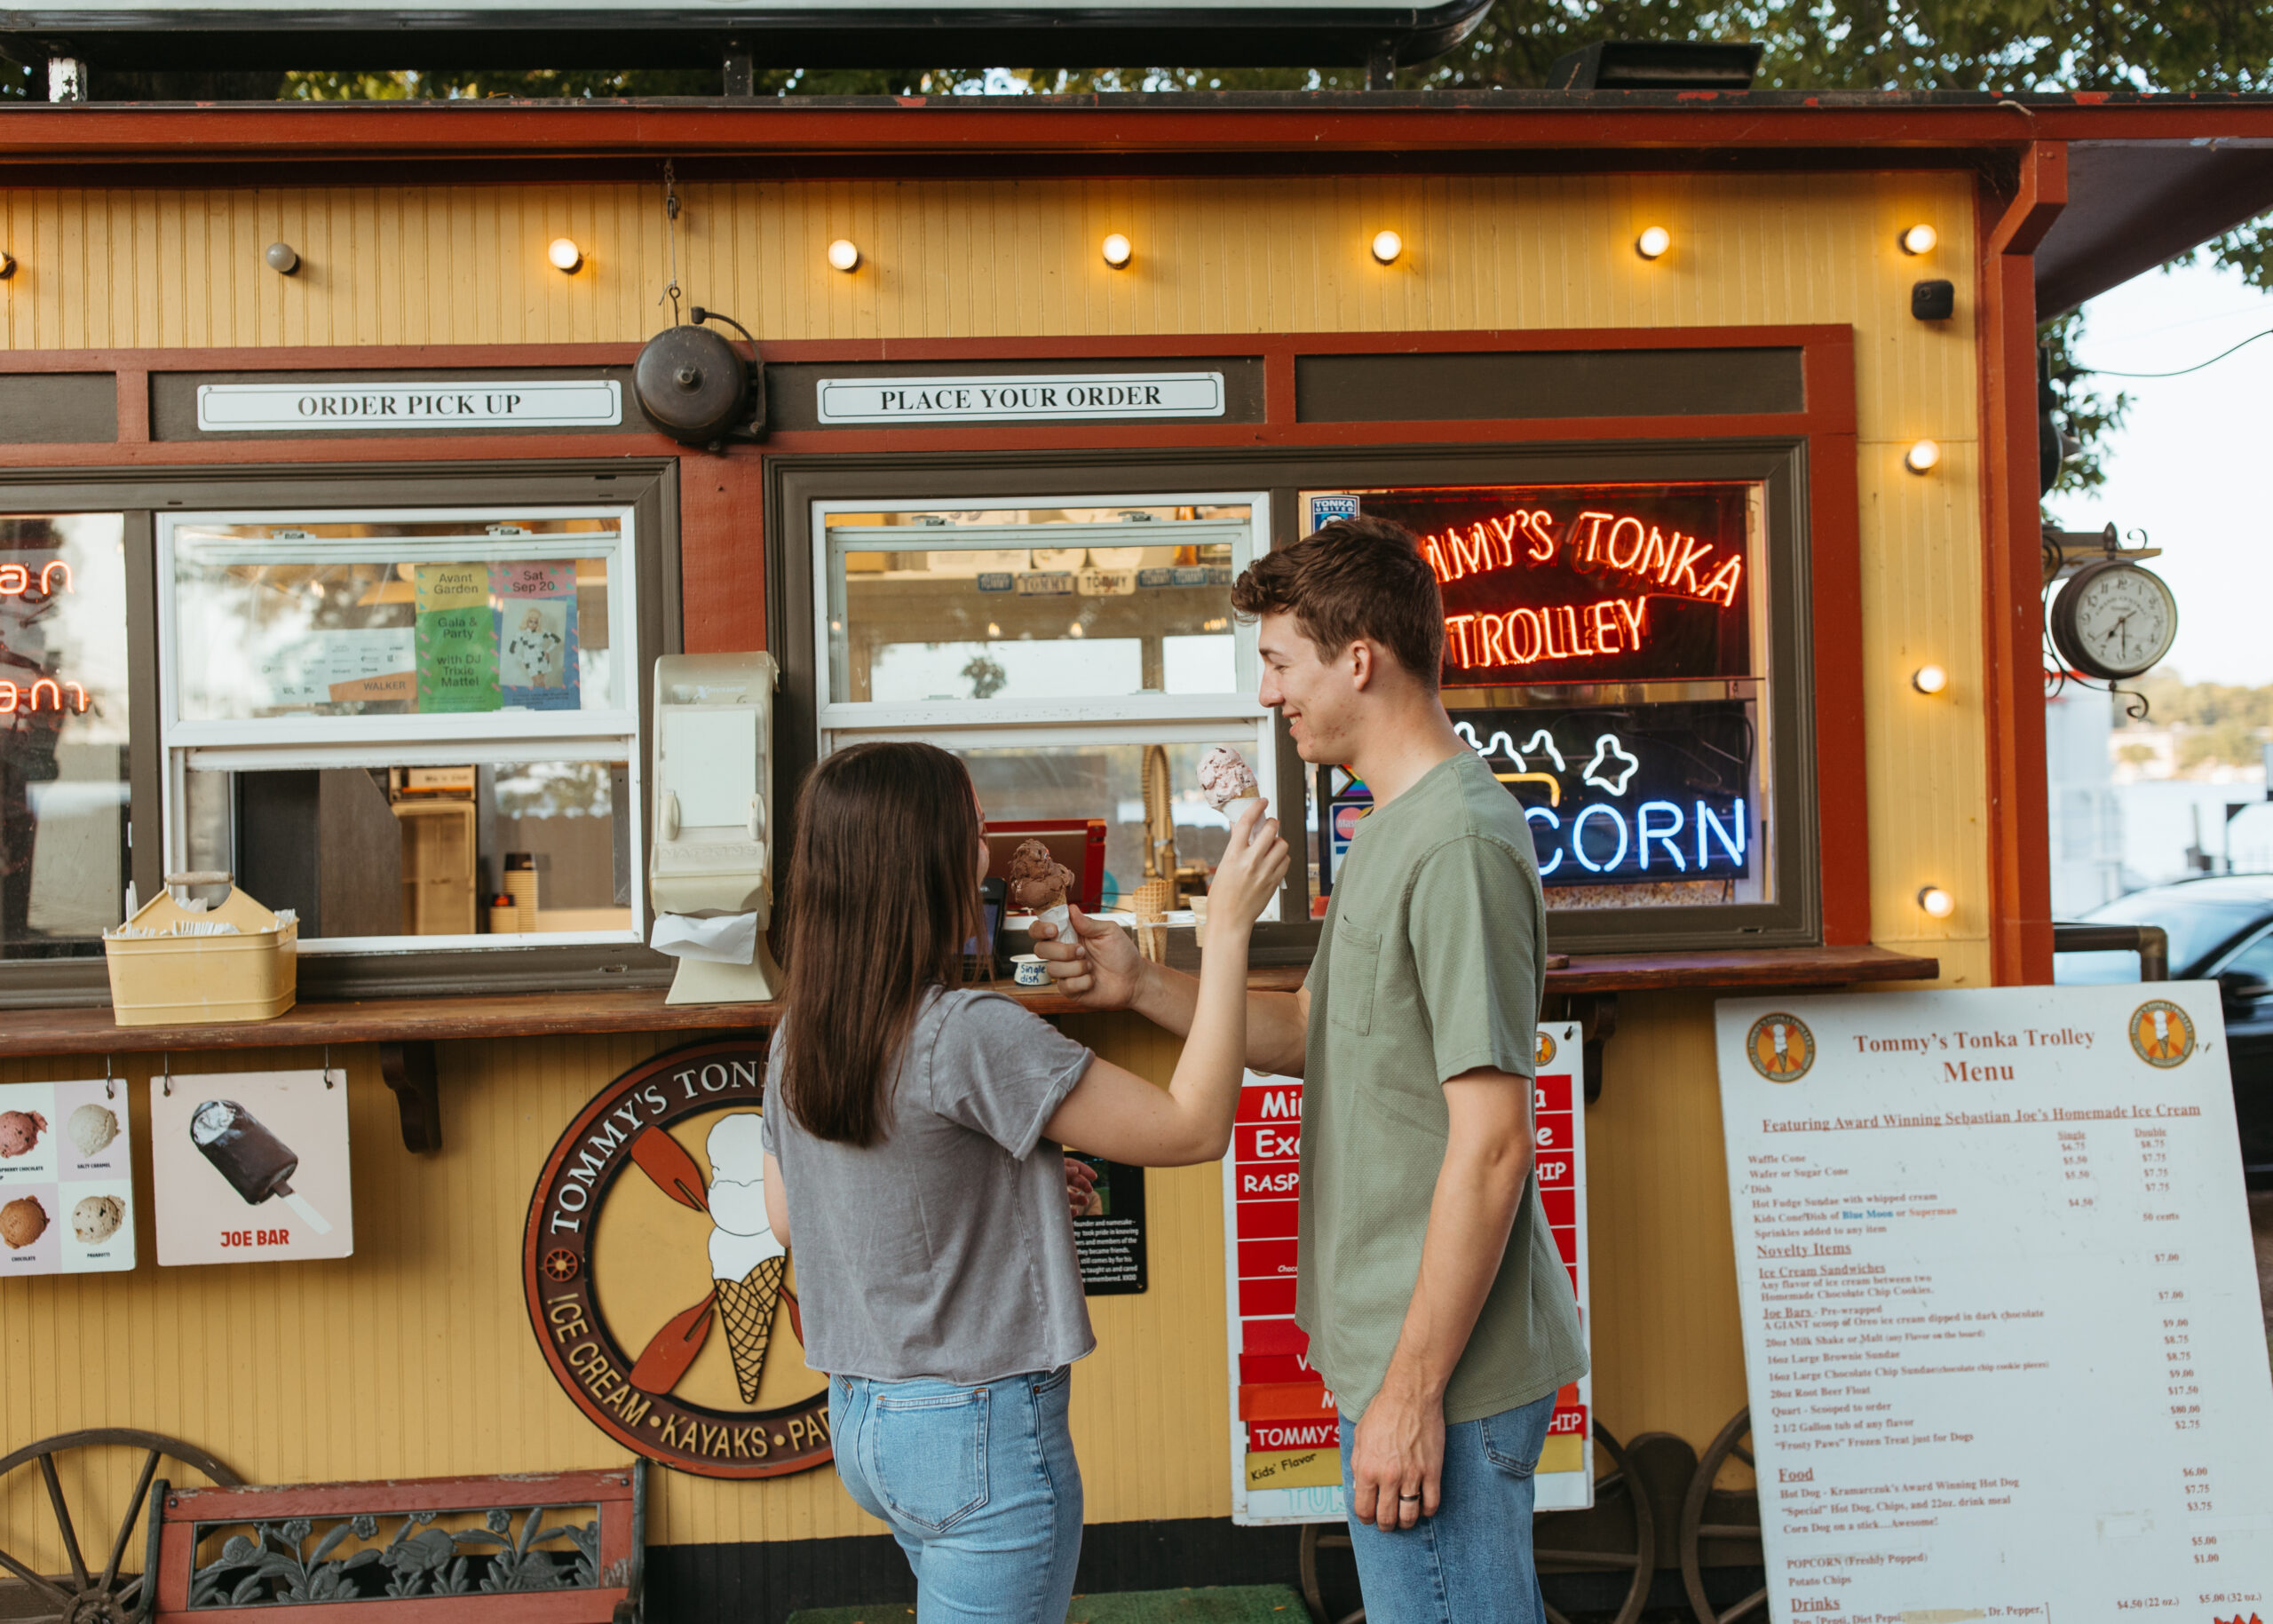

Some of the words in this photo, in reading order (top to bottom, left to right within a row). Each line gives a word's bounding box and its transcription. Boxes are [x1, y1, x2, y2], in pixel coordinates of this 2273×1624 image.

[297, 395, 397, 416] ORDER
[408, 395, 475, 415] PICK
[485, 395, 521, 413] UP
[881, 390, 971, 410] PLACE
[980, 388, 1057, 408] YOUR
[1066, 387, 1162, 408] ORDER
[1580, 511, 1740, 606] TONKA
[439, 574, 472, 582] Avant
[524, 571, 543, 581] Sat
[434, 584, 478, 594] Garden
[513, 582, 536, 593] Sep
[540, 582, 555, 590] 20
[438, 618, 465, 628] Gala
[469, 617, 477, 626] &
[443, 630, 473, 640] Party
[1445, 596, 1645, 669] TROLLEY
[437, 655, 463, 664] with
[466, 654, 481, 664] DJ
[444, 666, 473, 676] Trixie
[364, 682, 406, 691] WALKER
[441, 677, 479, 686] Mattel
[1525, 798, 1745, 876] CORN
[1020, 974, 1039, 983] dish
[1021, 964, 1045, 978] Single
[1853, 1033, 1948, 1055] Tommy's
[1953, 1030, 2016, 1050] Tonka
[2024, 1028, 2095, 1049] Trolley
[1944, 1061, 2014, 1083] Menu
[1762, 1118, 1830, 1133] Featuring
[1834, 1115, 1878, 1129] Award
[1883, 1113, 1941, 1128] Winning
[1945, 1112, 2010, 1125] Sebastian
[2015, 1109, 2048, 1122] Joe's
[2053, 1105, 2127, 1121] Homemade
[2133, 1105, 2151, 1118] Ice
[2156, 1104, 2201, 1117] Cream
[2057, 1131, 2086, 1141] Single
[2134, 1128, 2166, 1137] Double
[550, 1085, 667, 1234] TOMMY'S
[673, 1061, 769, 1098] TON
[1781, 1154, 1805, 1163] Cone
[1749, 1170, 1777, 1179] Wafer
[1794, 1168, 1821, 1178] Sugar
[1773, 1199, 1801, 1208] Fudge
[1843, 1195, 1863, 1204] with
[1866, 1194, 1905, 1203] whipped
[1842, 1210, 1864, 1220] Blue
[1866, 1209, 1893, 1218] Moon
[1909, 1208, 1957, 1217] Superman
[1754, 1230, 1800, 1240] Sprinkles
[1802, 1227, 1832, 1237] added
[1847, 1227, 1863, 1236] any
[1866, 1224, 1887, 1233] item
[2142, 1213, 2153, 1222] 50
[2156, 1213, 2180, 1222] cents
[220, 1231, 251, 1248] JOE
[257, 1229, 289, 1245] BAR
[1757, 1244, 1808, 1259] Novelty
[1814, 1243, 1851, 1256] Items
[1759, 1268, 1775, 1279] Ice
[1779, 1267, 1817, 1277] Cream
[1820, 1264, 1886, 1276] Sandwiches
[2155, 1254, 2179, 1263] $7.00
[1763, 1308, 1781, 1319] Joe
[1786, 1308, 1811, 1319] Bars
[1821, 1305, 1882, 1317] Pre-wrapped
[547, 1293, 589, 1343] ICE
[569, 1342, 651, 1427] CREAM
[661, 1414, 767, 1457] KAYAKS
[1251, 1464, 1276, 1481] Kids'
[1281, 1454, 1317, 1470] Flavor
[1778, 1468, 1813, 1483] Food
[1780, 1490, 1798, 1499] Hot
[1801, 1489, 1821, 1499] Dog
[1830, 1484, 1899, 1496] Kramarczuk's
[1902, 1482, 1932, 1492] Award
[1936, 1481, 1976, 1490] Winning
[1980, 1478, 1997, 1488] Hot
[2000, 1477, 2019, 1488] Dog
[2182, 1467, 2207, 1477] $6.00
[1786, 1557, 1841, 1569] POPCORN
[1845, 1555, 1884, 1565] (Freshly
[1889, 1553, 1928, 1565] Popped)
[2192, 1536, 2216, 1546] $5.00
[1788, 1577, 1820, 1587] Potato
[1823, 1575, 1851, 1587] Chips
[2194, 1553, 2219, 1564] $1.00
[1790, 1597, 1841, 1612] Drinks
